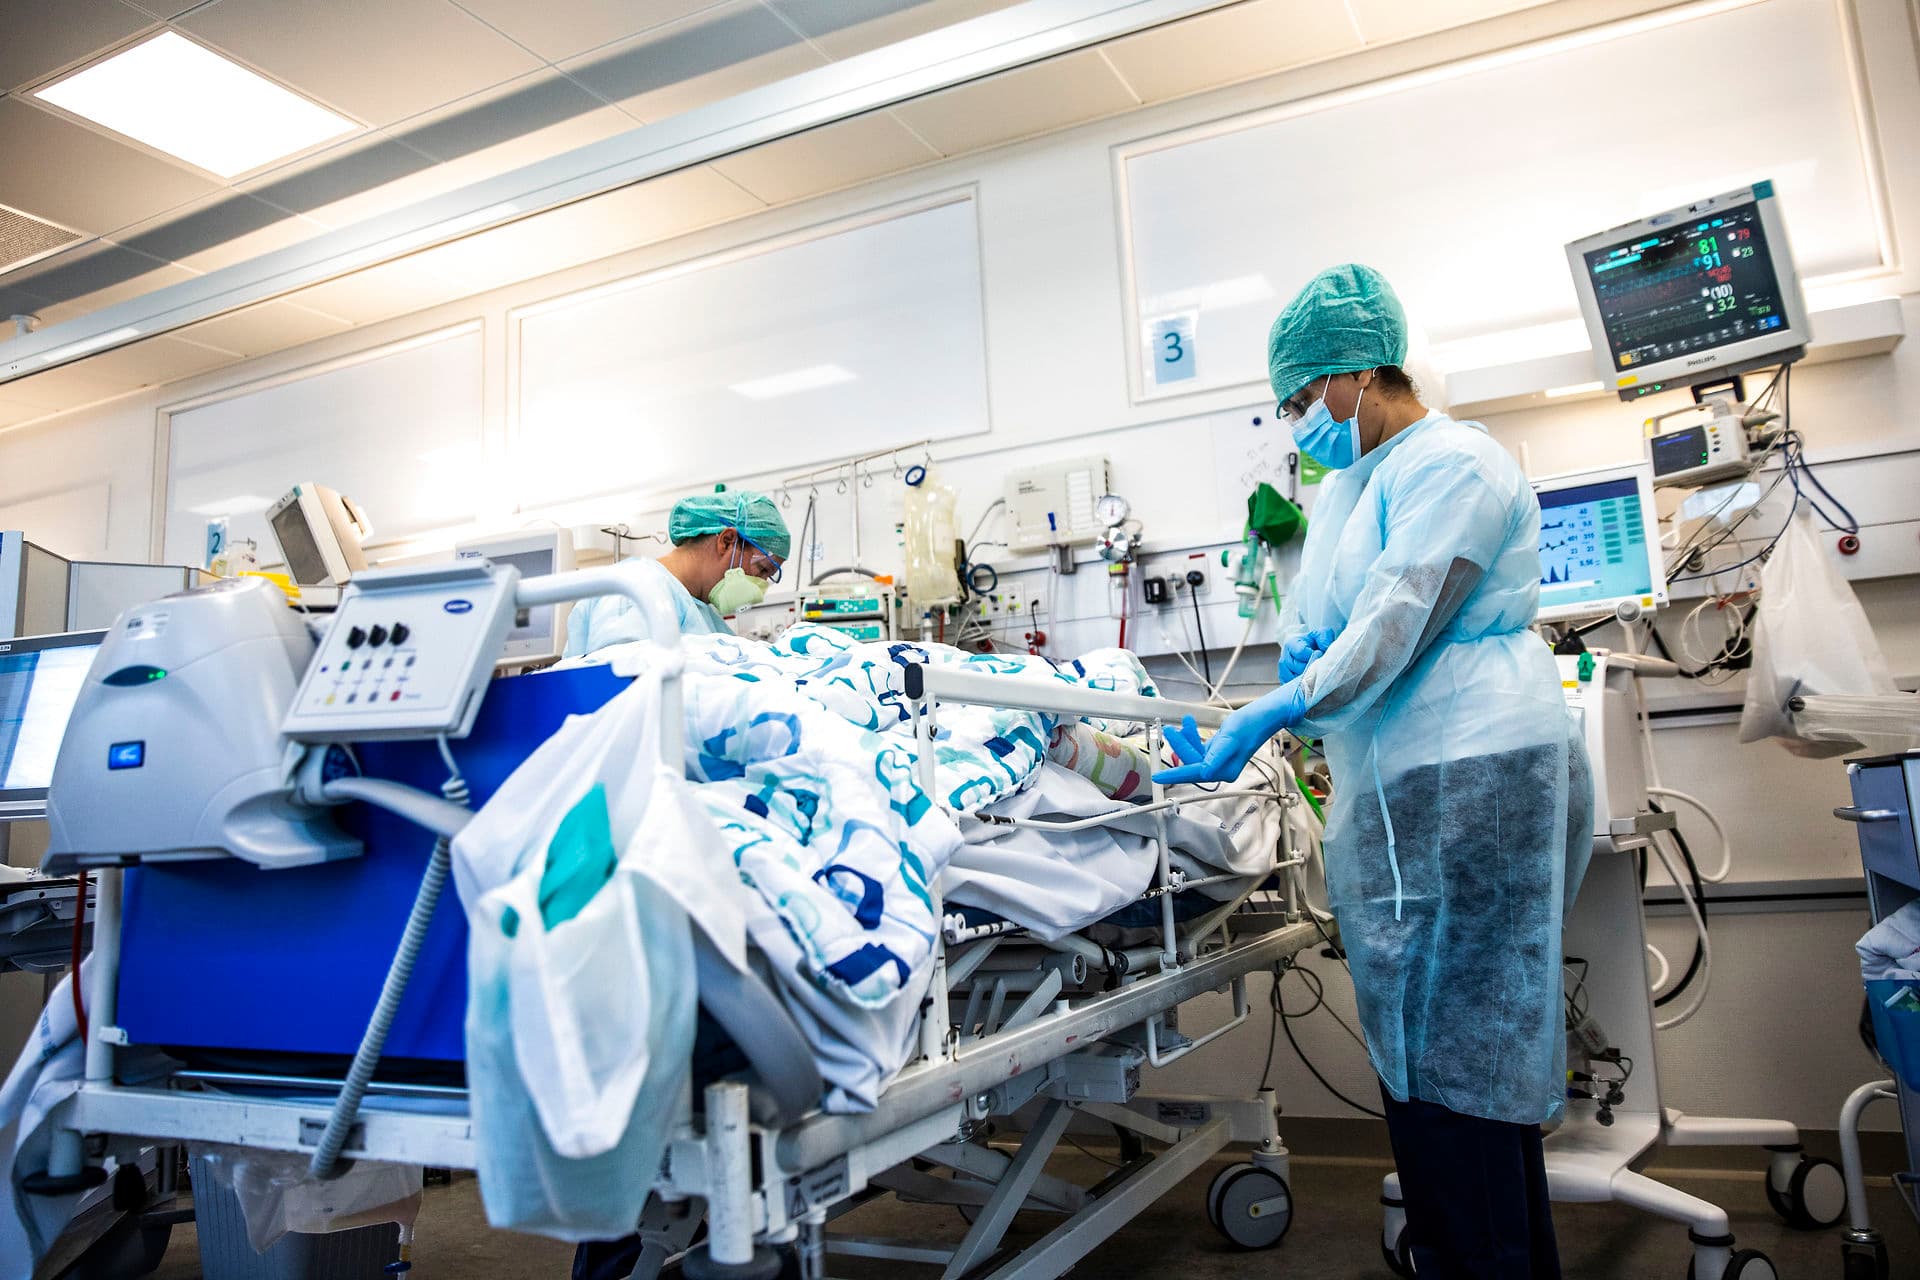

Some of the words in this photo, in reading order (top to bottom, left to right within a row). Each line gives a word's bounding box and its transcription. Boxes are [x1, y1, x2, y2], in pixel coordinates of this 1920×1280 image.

[1737, 228, 1750, 240] 79
[1698, 236, 1718, 254] 81
[1741, 246, 1754, 258] 23
[1701, 252, 1721, 270] 91
[1164, 332, 1184, 363] 3
[211, 532, 221, 554] 2
